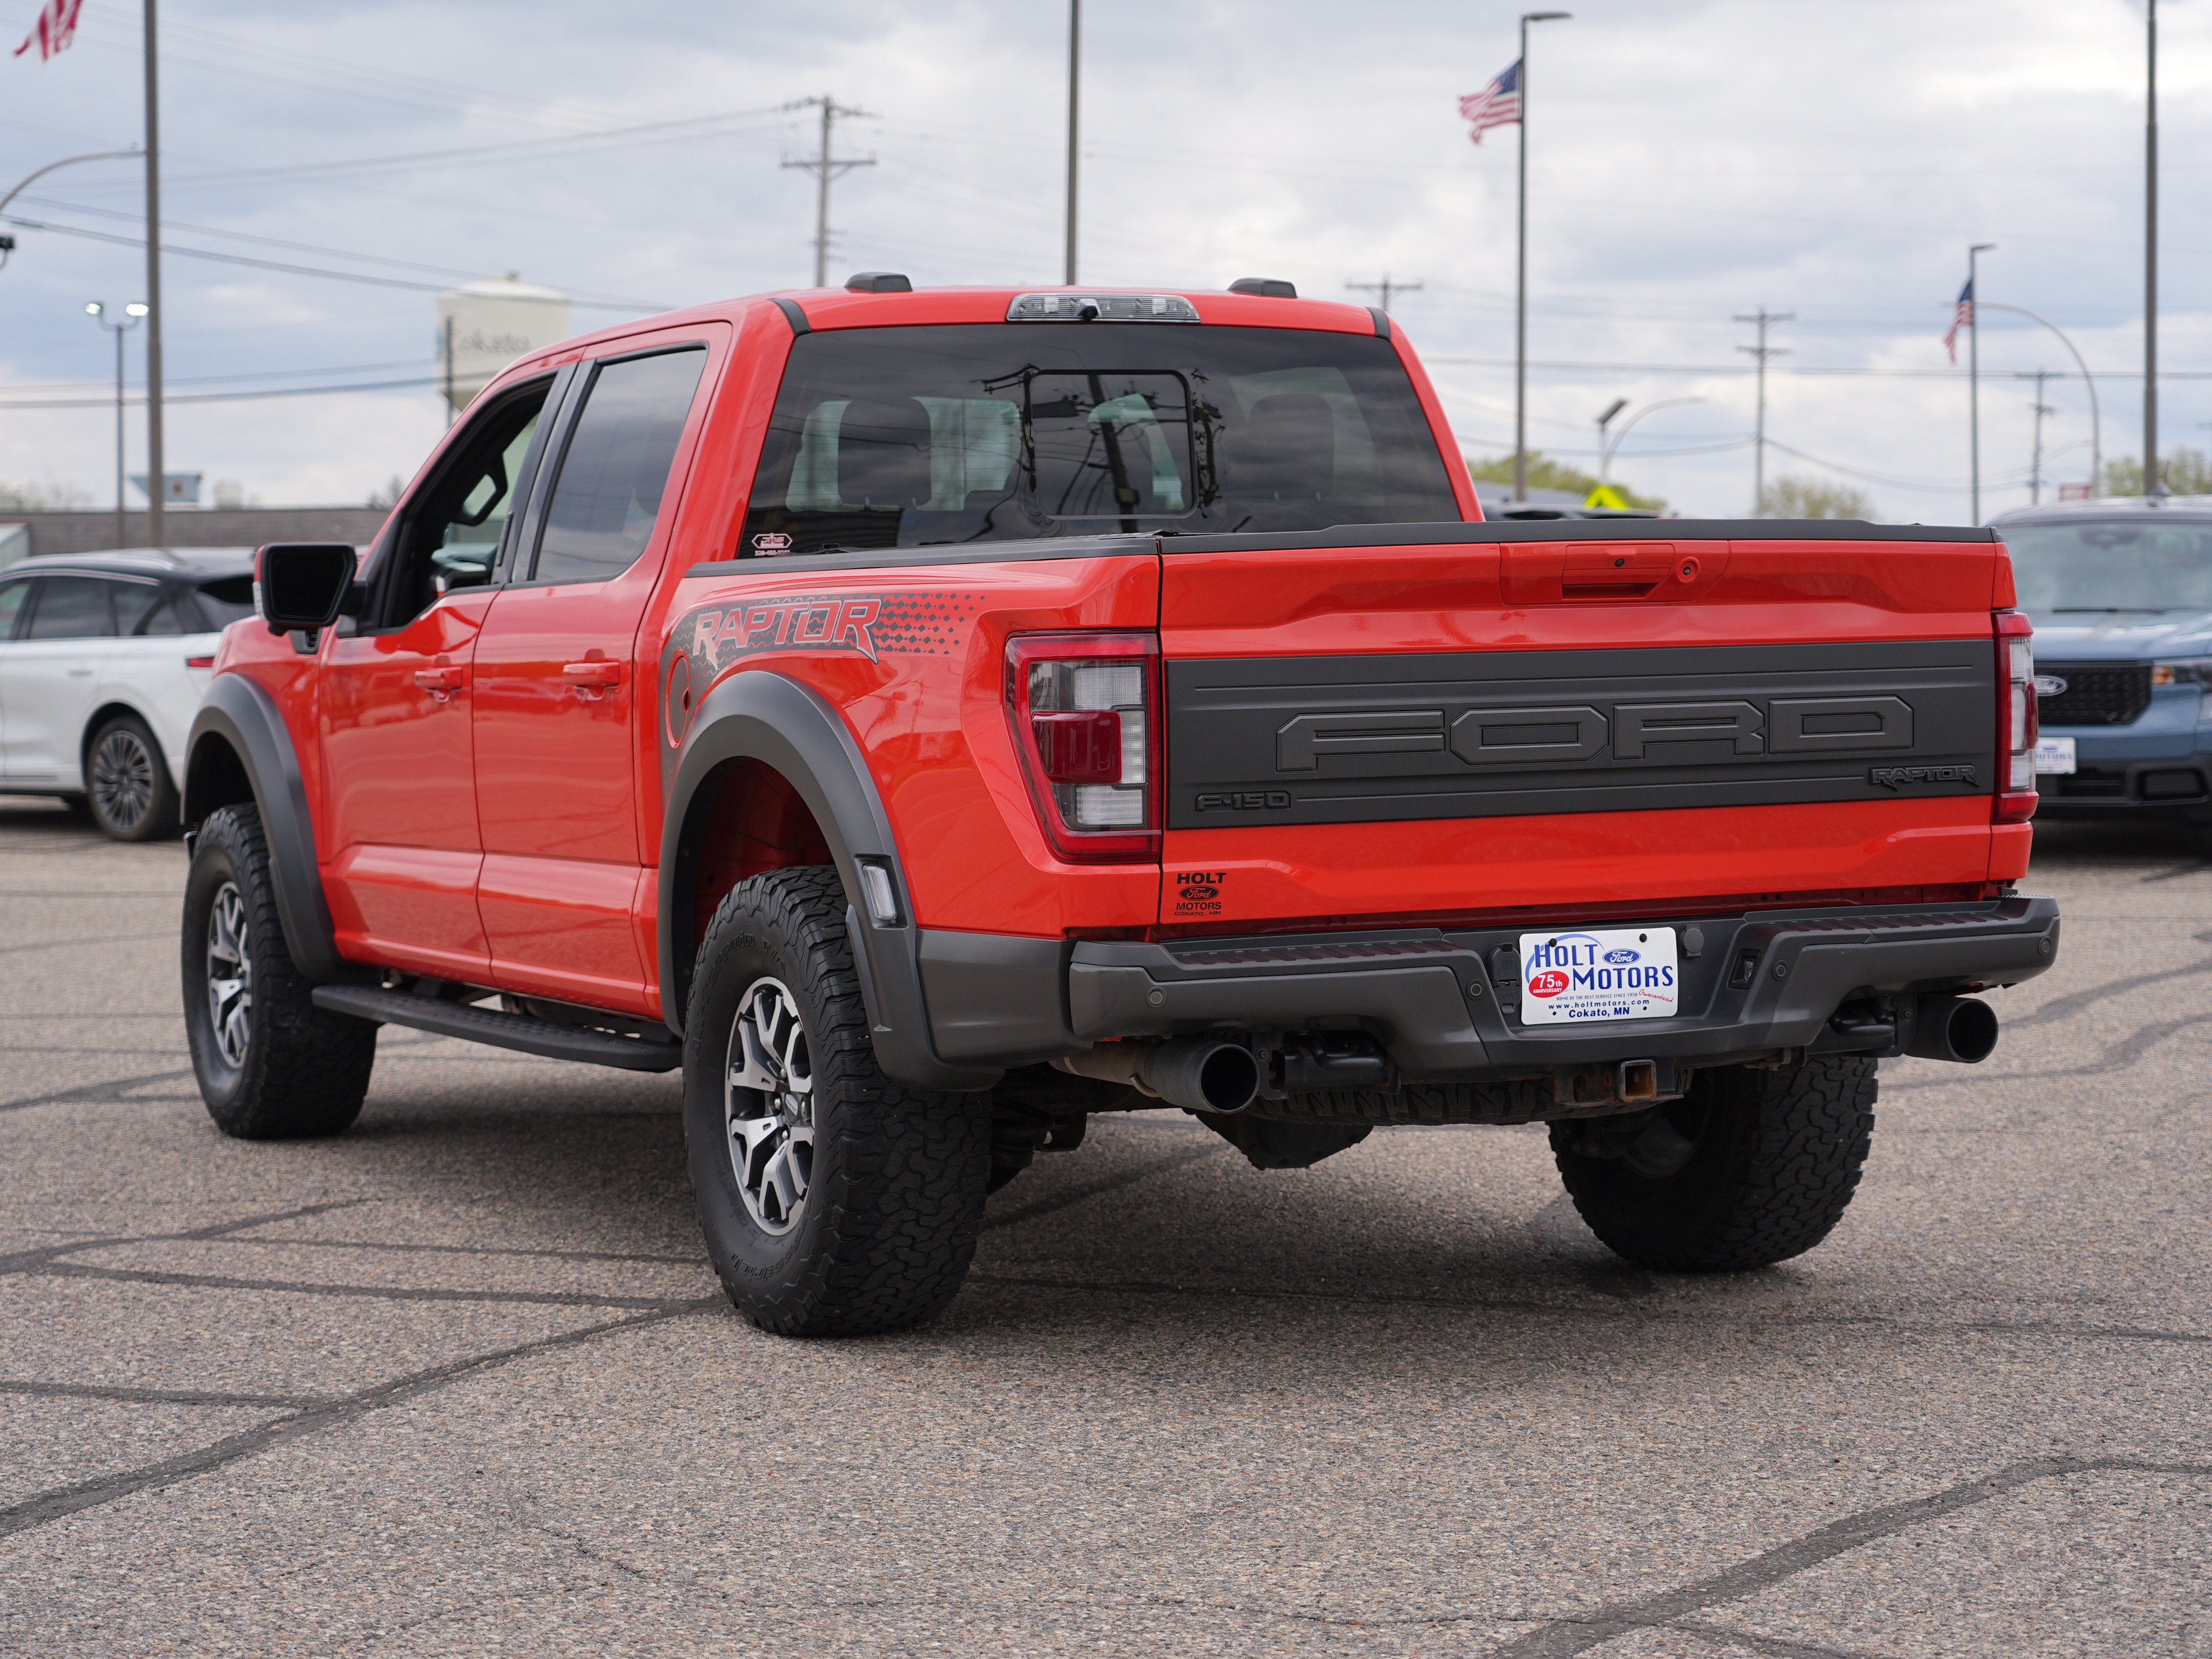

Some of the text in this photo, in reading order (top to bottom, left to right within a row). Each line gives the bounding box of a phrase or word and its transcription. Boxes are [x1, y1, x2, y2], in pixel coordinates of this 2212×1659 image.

[691, 598, 882, 670] RAPTOR
[1276, 694, 1914, 772] FORD
[1869, 764, 1979, 792] RAPTOR
[1195, 791, 1291, 812] F-150
[1177, 873, 1226, 884] HOLT
[1186, 887, 1212, 899] Ford
[1176, 902, 1222, 910] MOTORS
[1534, 944, 1597, 968] HOLT
[1610, 951, 1633, 963] Ford
[1537, 974, 1563, 988] 75th
[1573, 966, 1673, 990] MOTORS
[1548, 999, 1649, 1009] www.holtmotors.com
[1569, 1007, 1630, 1018] Cokato, MN
